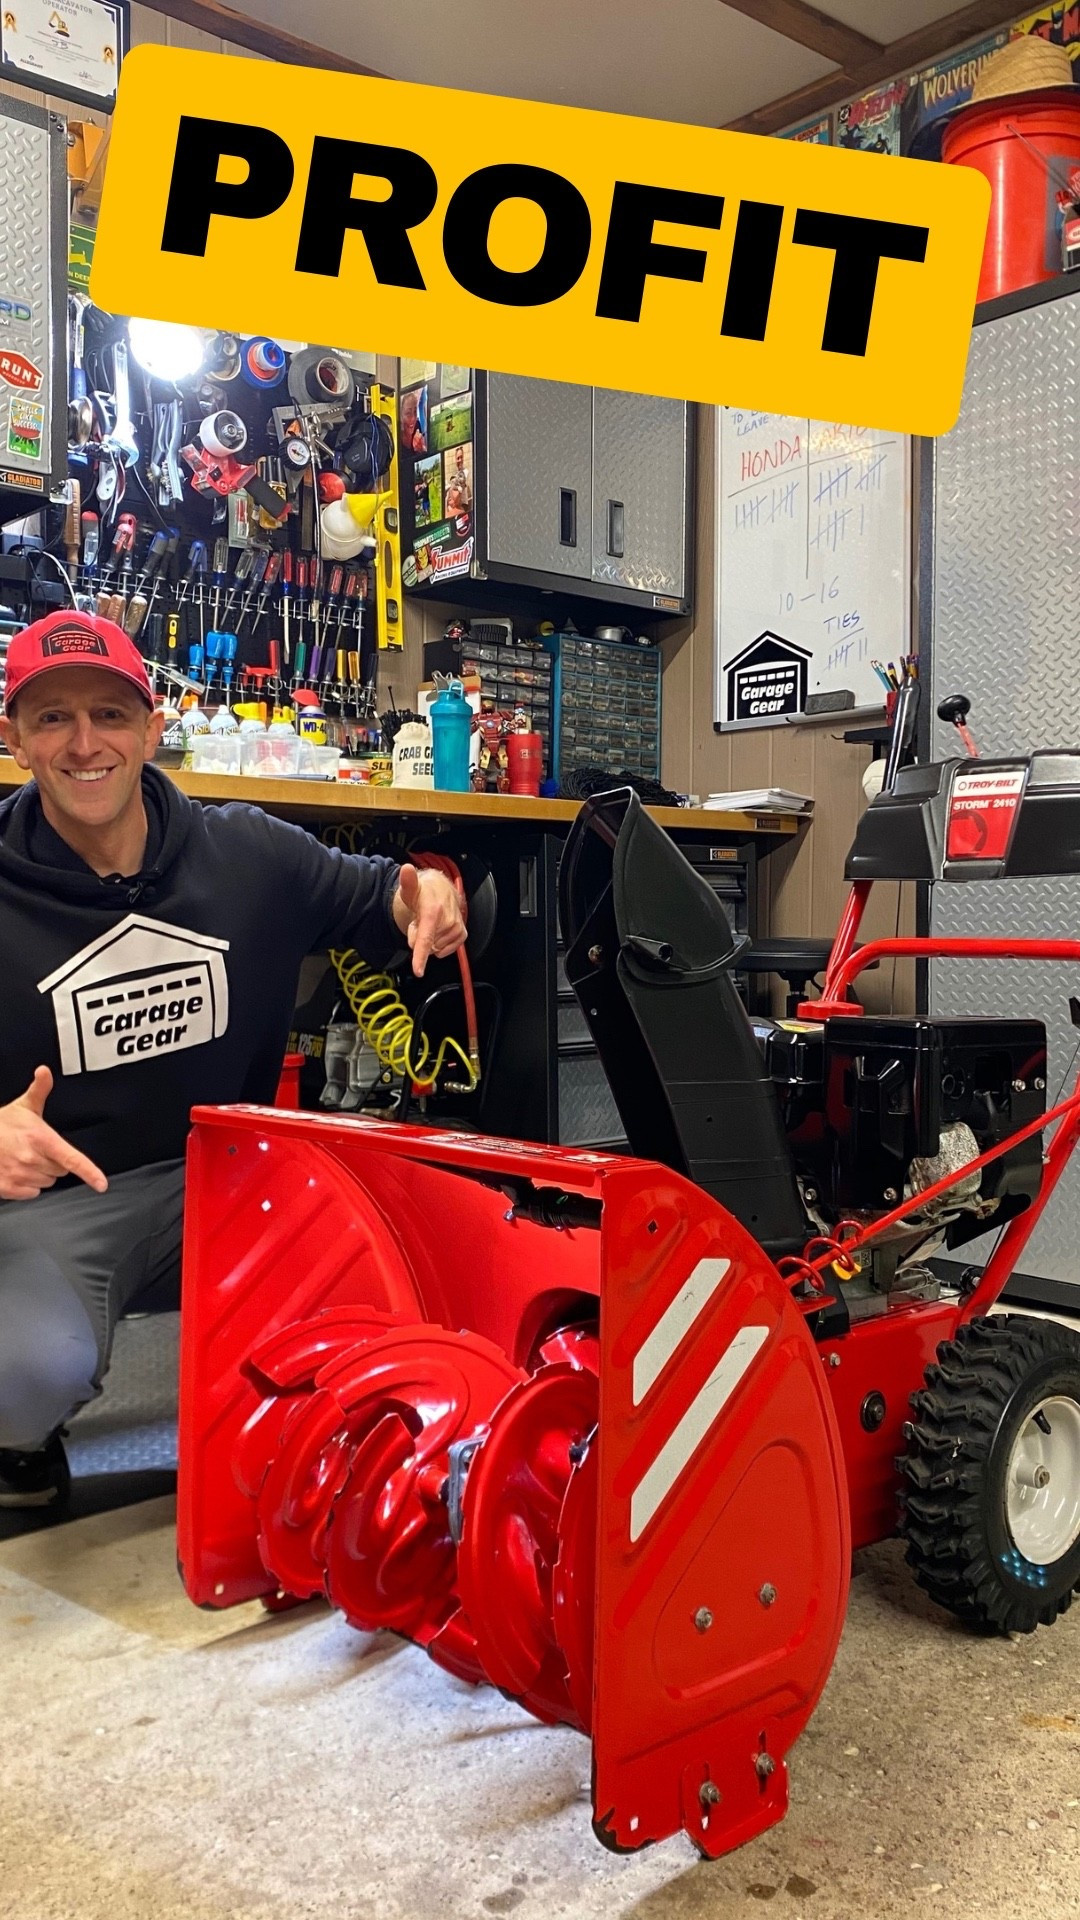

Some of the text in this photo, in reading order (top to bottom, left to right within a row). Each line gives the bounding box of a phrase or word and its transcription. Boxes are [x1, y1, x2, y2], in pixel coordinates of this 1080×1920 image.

[0, 357, 41, 387] RUNT
[737, 414, 769, 437] LEAVE
[741, 435, 801, 481] HONDA
[823, 610, 860, 633] TIES
[55, 639, 96, 647] Garage
[741, 682, 795, 701] Garage
[750, 699, 785, 715] Gear
[303, 722, 327, 733] WD-4
[400, 746, 421, 761] CRAB
[967, 779, 1019, 790] TROY-BILT
[993, 798, 1017, 808] 2410
[94, 996, 203, 1036] Garage
[117, 1024, 188, 1056] Gear
